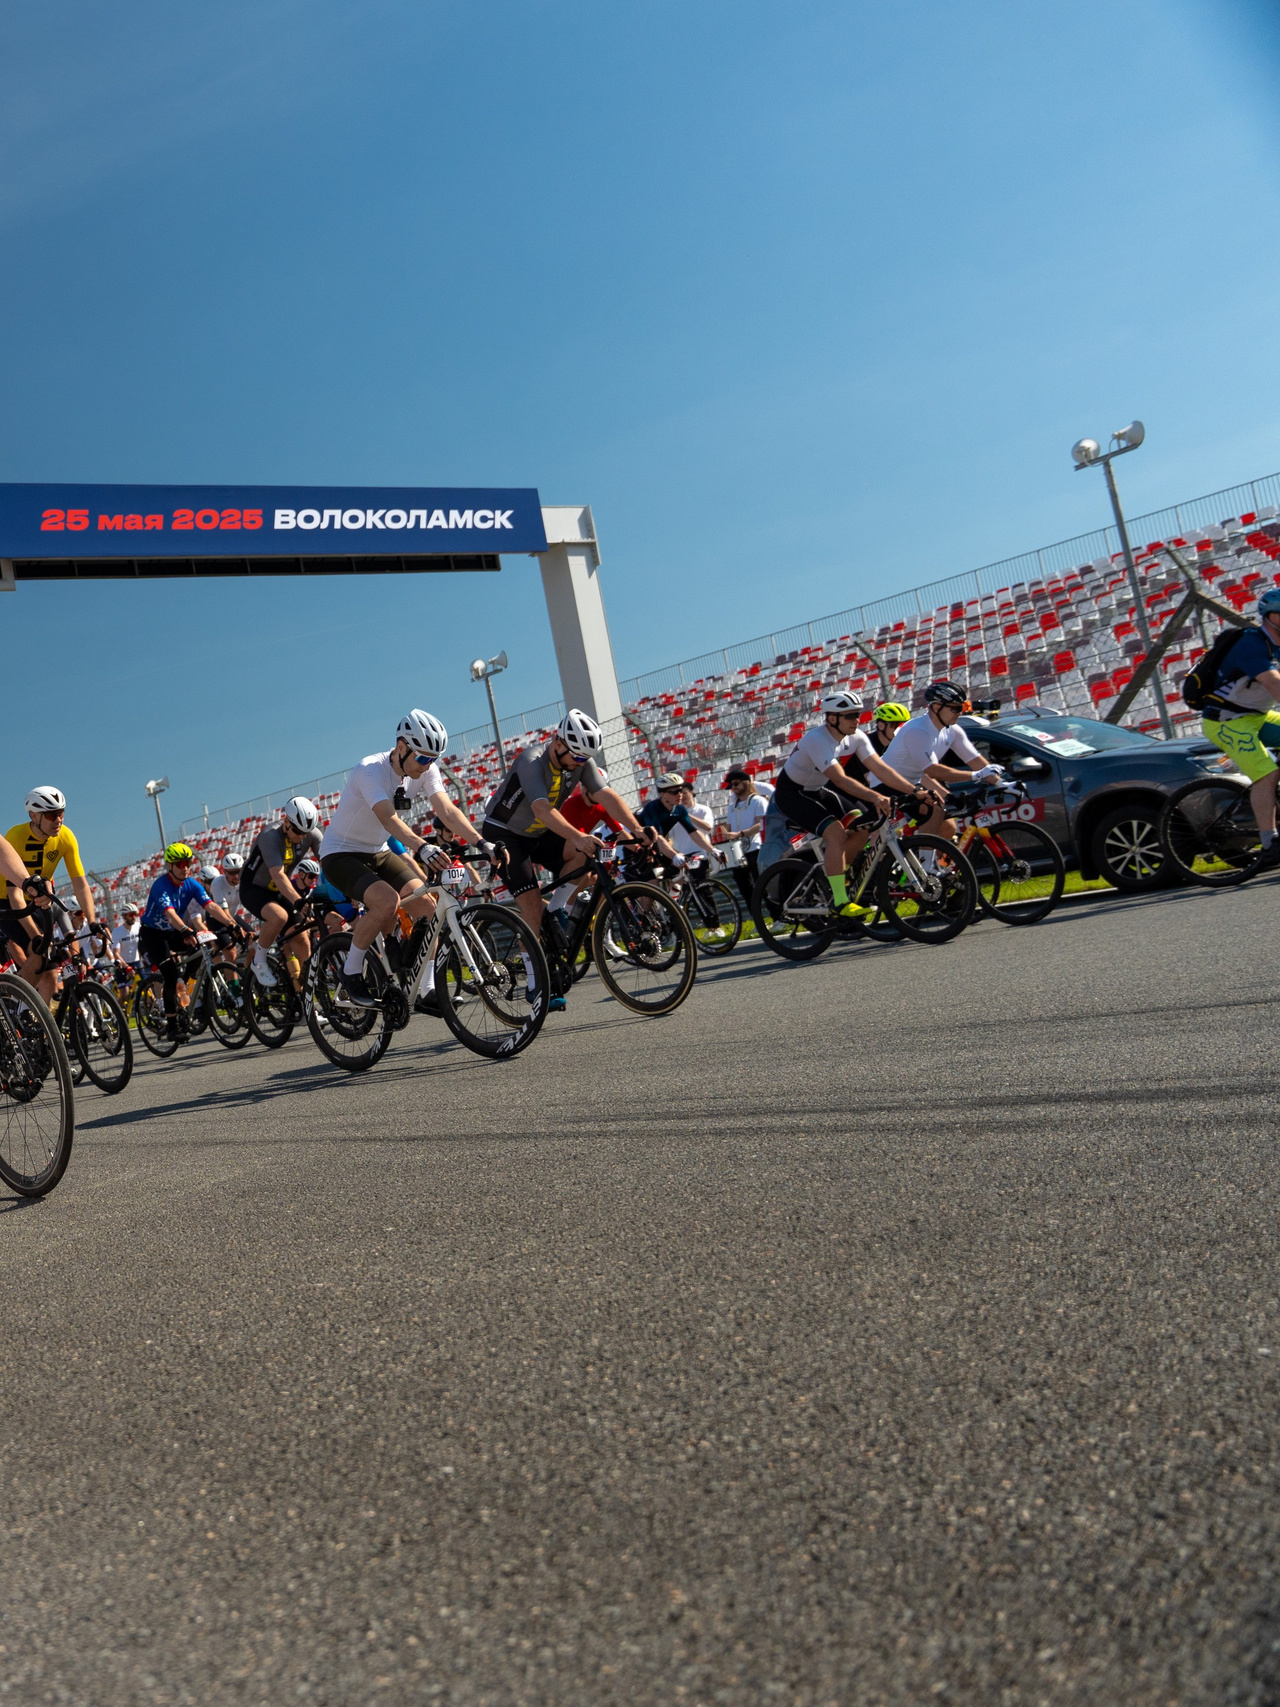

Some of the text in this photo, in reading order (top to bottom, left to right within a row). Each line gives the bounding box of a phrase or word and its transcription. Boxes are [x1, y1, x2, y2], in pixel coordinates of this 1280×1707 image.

[40, 509, 514, 531] 25 мая 2025 ВОЛОКОЛАМСК
[447, 868, 465, 879] 1014
[405, 912, 439, 995] MERIDA
